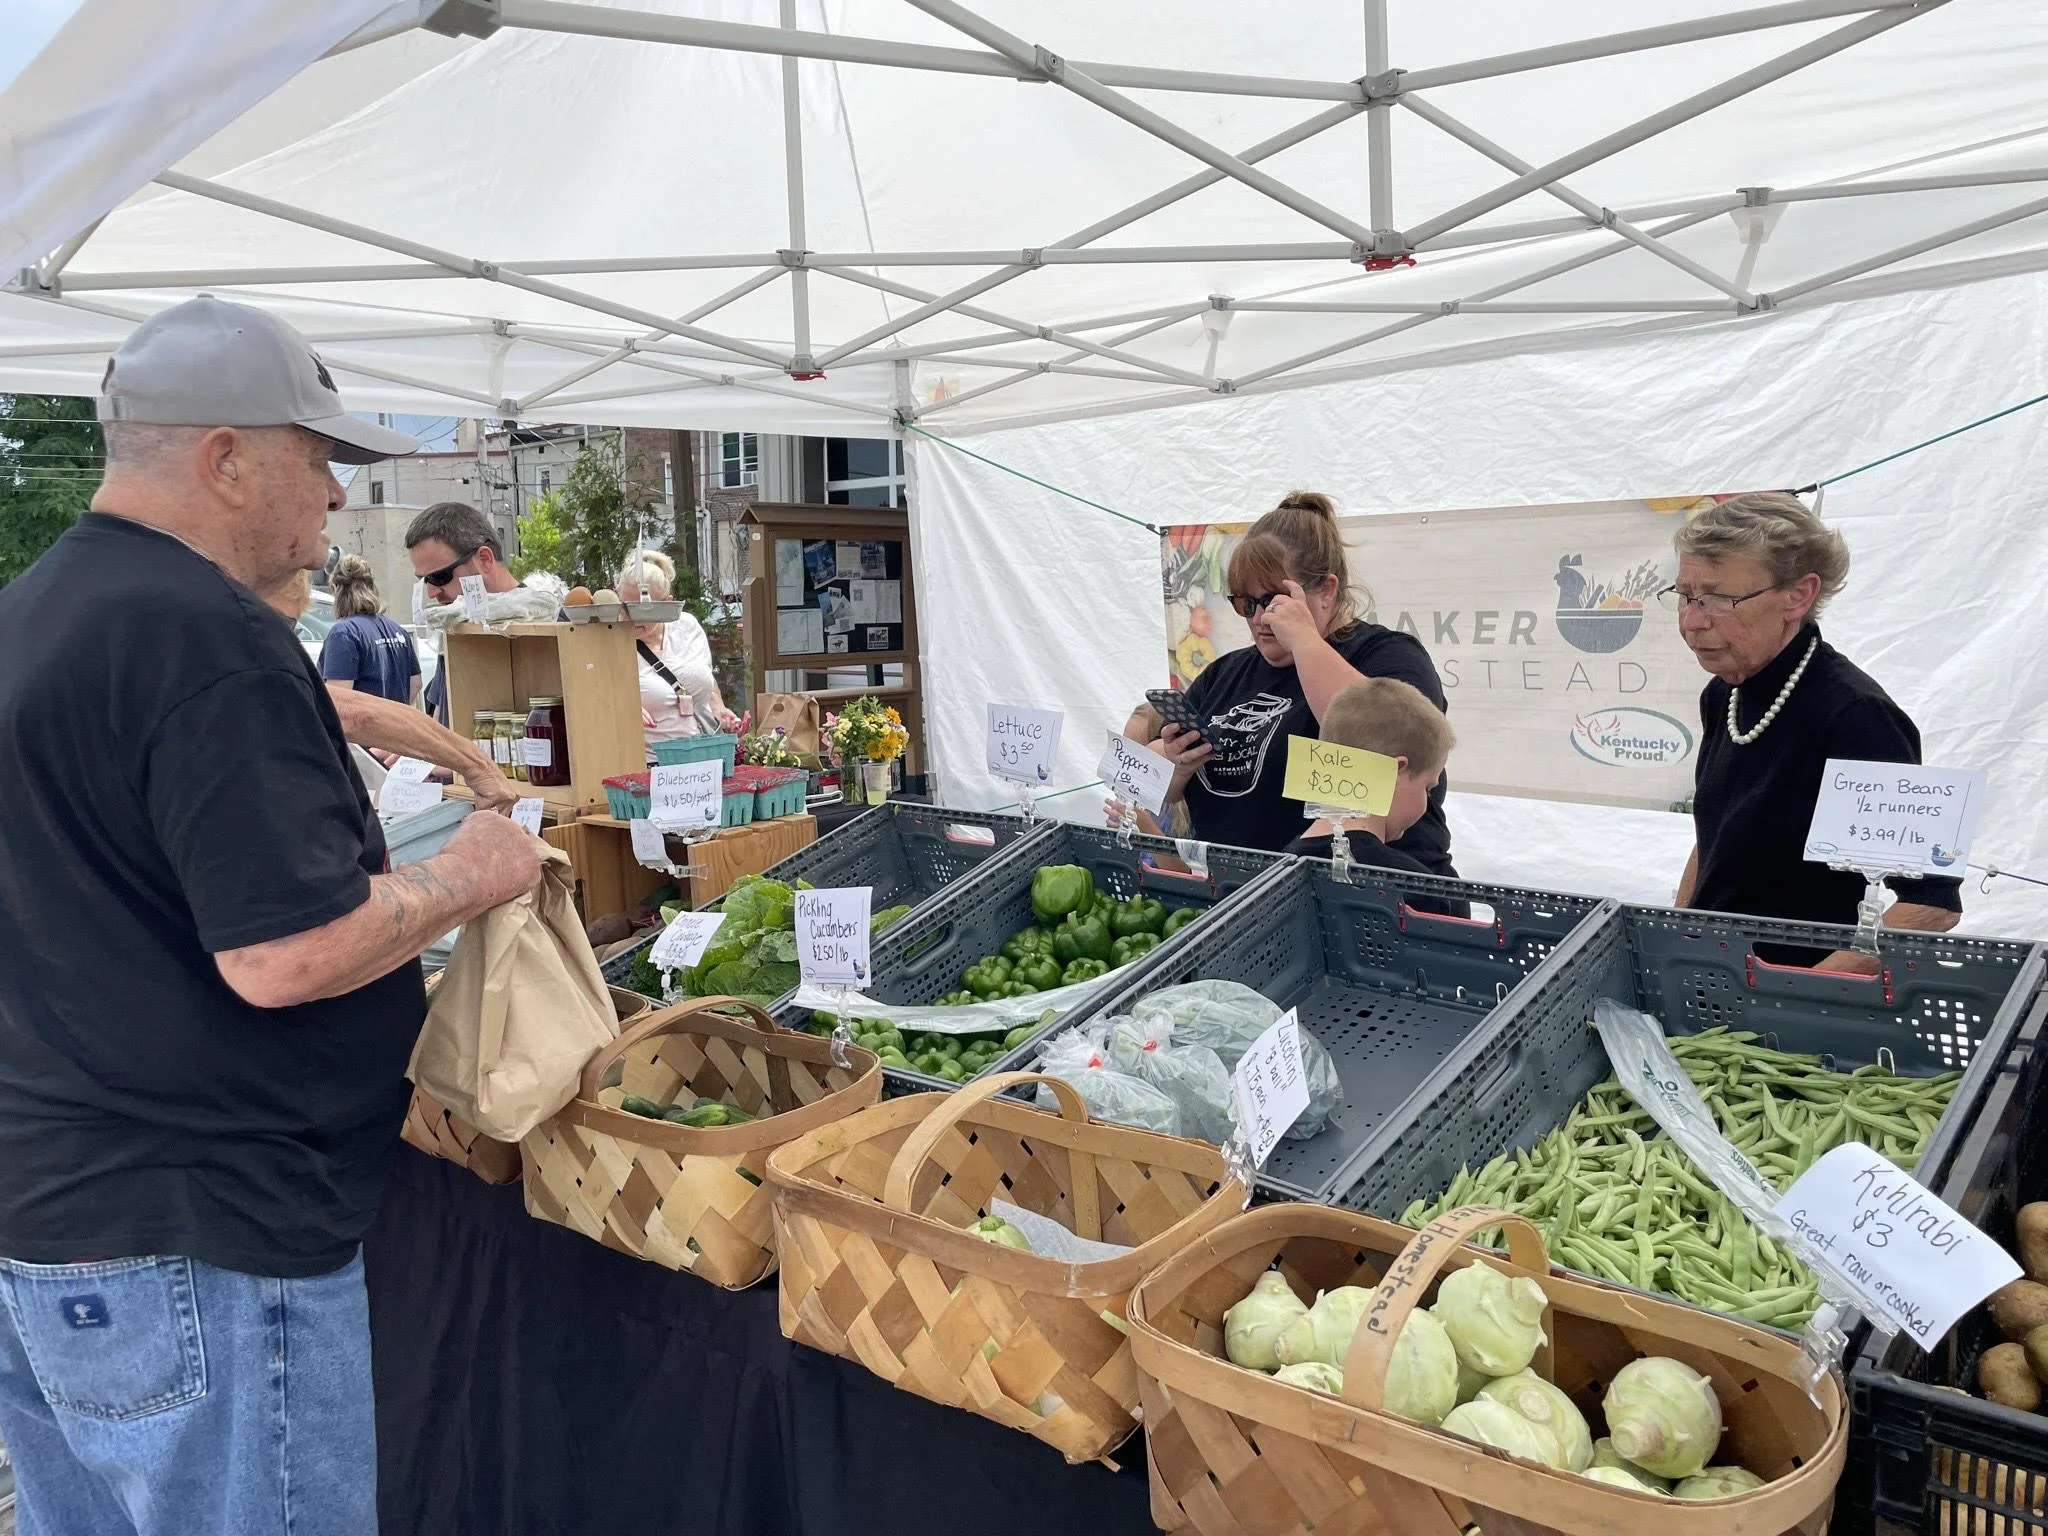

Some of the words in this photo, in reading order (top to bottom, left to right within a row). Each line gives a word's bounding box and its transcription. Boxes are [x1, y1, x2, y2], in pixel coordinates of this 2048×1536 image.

[1366, 611, 1538, 646] AKER
[992, 710, 1042, 739] Lettuce
[1228, 746, 1258, 762] LOCAL
[1310, 743, 1353, 768] Kale
[1600, 735, 1680, 753] Kentucky
[1615, 748, 1664, 762] Proud
[657, 771, 712, 787] Blueberries
[1308, 769, 1369, 799] $3.00
[1834, 773, 1884, 791] Green
[1897, 779, 1955, 797] Beans
[1879, 802, 1942, 817] runners
[1852, 1163, 1971, 1256] Kohlrabi
[1852, 1208, 1894, 1249] $3
[1790, 1209, 1837, 1251] Great
[1841, 1252, 1873, 1285] raw
[1874, 1281, 1893, 1298] or
[1885, 1292, 1936, 1338] cooked
